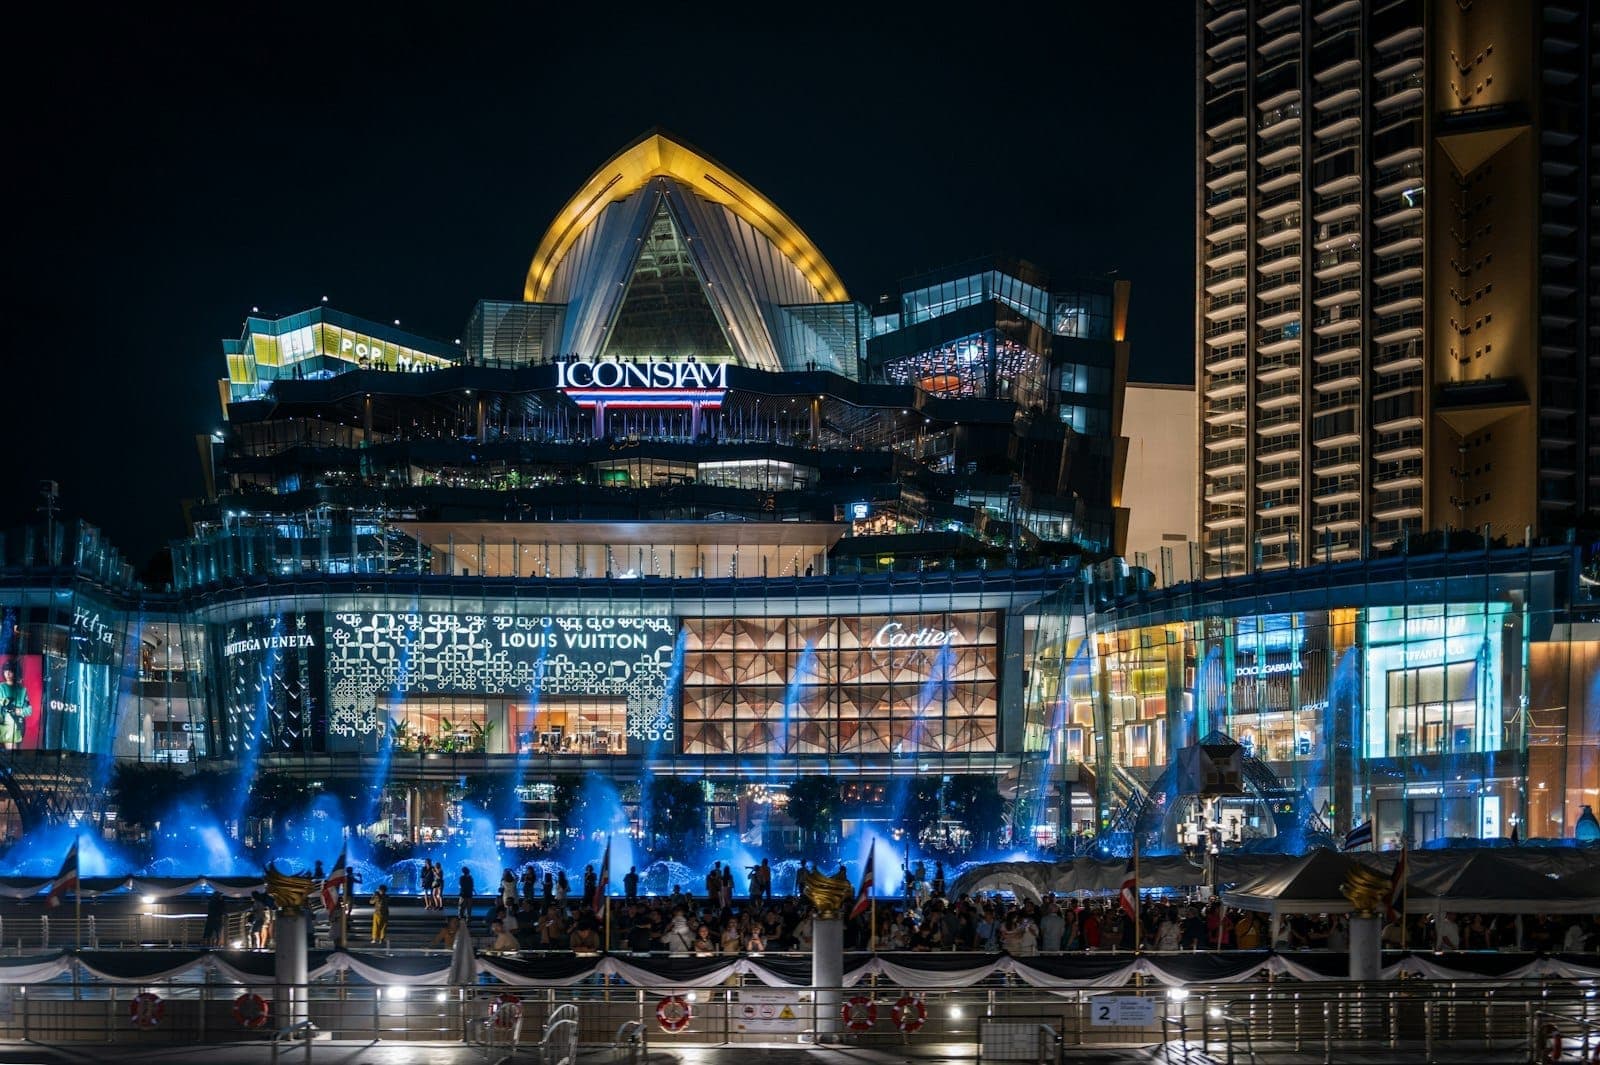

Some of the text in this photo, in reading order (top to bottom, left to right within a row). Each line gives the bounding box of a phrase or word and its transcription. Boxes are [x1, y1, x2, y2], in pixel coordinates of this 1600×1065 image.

[342, 338, 438, 373] POP MA
[555, 361, 728, 388] ICONSIAM
[224, 635, 315, 657] BOTTEGA VENETA
[501, 632, 648, 649] LOUIS VUITTON
[876, 622, 958, 647] Cartier
[1099, 1006, 1110, 1020] 2
